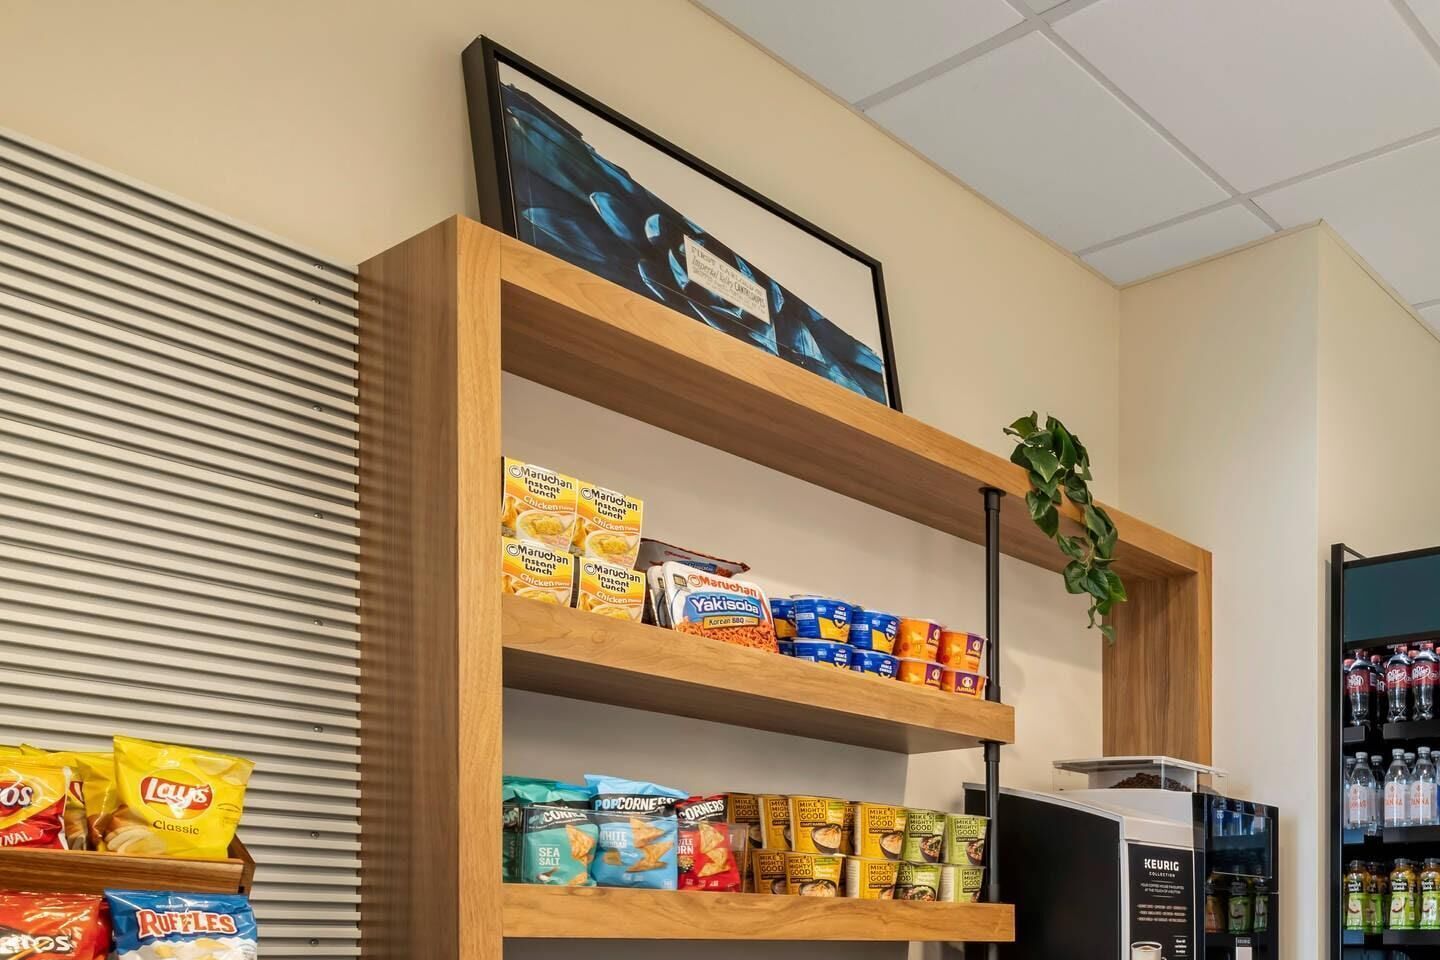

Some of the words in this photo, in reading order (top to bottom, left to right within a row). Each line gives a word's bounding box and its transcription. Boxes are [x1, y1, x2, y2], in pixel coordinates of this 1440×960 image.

[521, 466, 573, 489] Maruchan
[525, 478, 560, 494] Instant
[529, 486, 556, 499] Lunch
[523, 496, 558, 511] Chicken
[591, 489, 638, 511] Maruchan
[595, 500, 627, 515] Instant
[598, 508, 623, 520] Lunch
[593, 517, 625, 531] Chicken
[518, 545, 569, 565] Maruchan
[522, 555, 556, 569] Instant
[525, 563, 552, 576] Lunch
[594, 564, 641, 583] Maruchan
[520, 574, 554, 587] Chicken
[598, 574, 629, 588] Instant
[601, 582, 626, 593] Lunch
[699, 576, 757, 597] Maruchan
[597, 591, 628, 603] Chicken
[691, 597, 759, 615] Yakisoba
[145, 778, 209, 806] Lay's
[153, 820, 200, 835] Classic
[538, 847, 560, 857] SEA
[538, 857, 560, 866] SALT
[1144, 858, 1179, 871] KEURIG
[138, 910, 238, 937] RUFFLES
